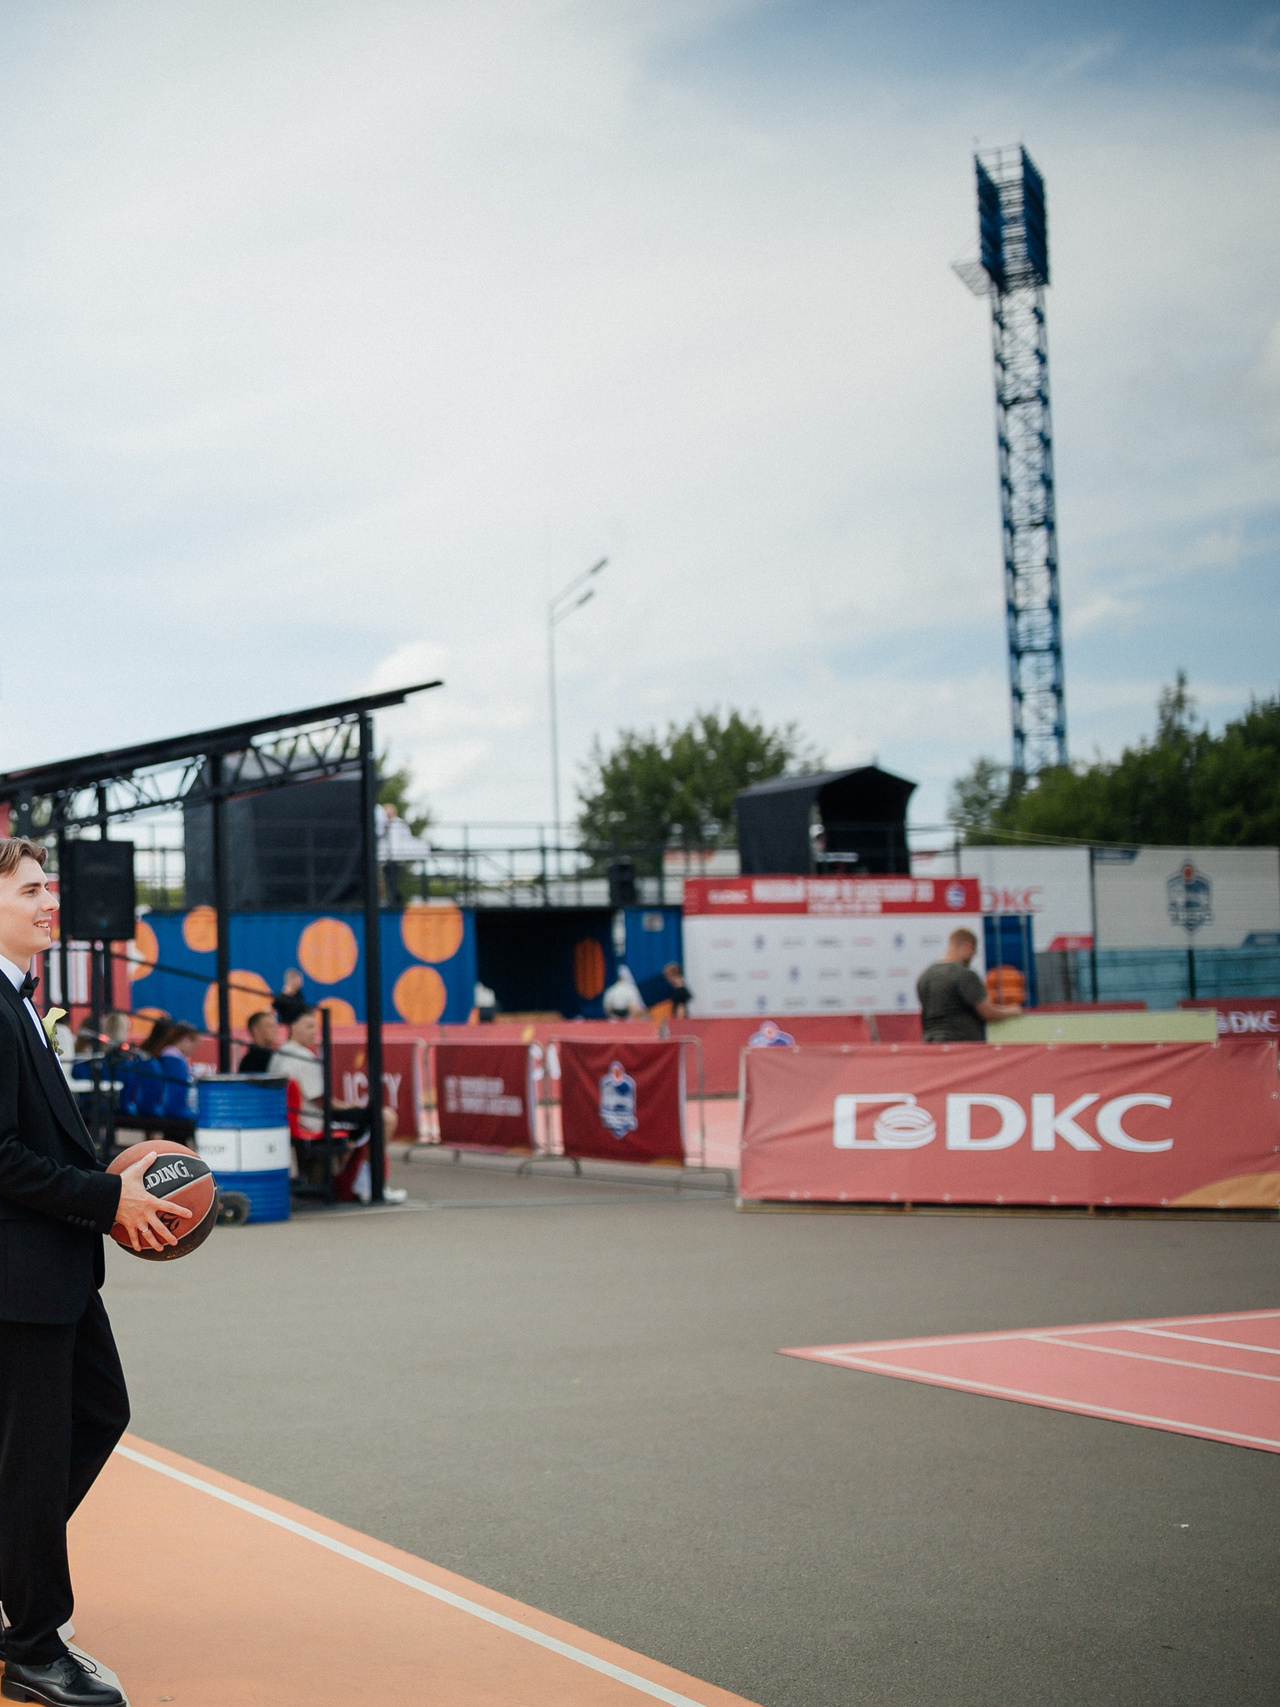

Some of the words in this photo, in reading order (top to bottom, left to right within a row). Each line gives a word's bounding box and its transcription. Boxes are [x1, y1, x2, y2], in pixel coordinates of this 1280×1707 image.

[980, 885, 1044, 913] DKC
[1229, 1010, 1280, 1034] DKC
[945, 1092, 1174, 1153] DKC
[143, 1159, 191, 1191] DING
